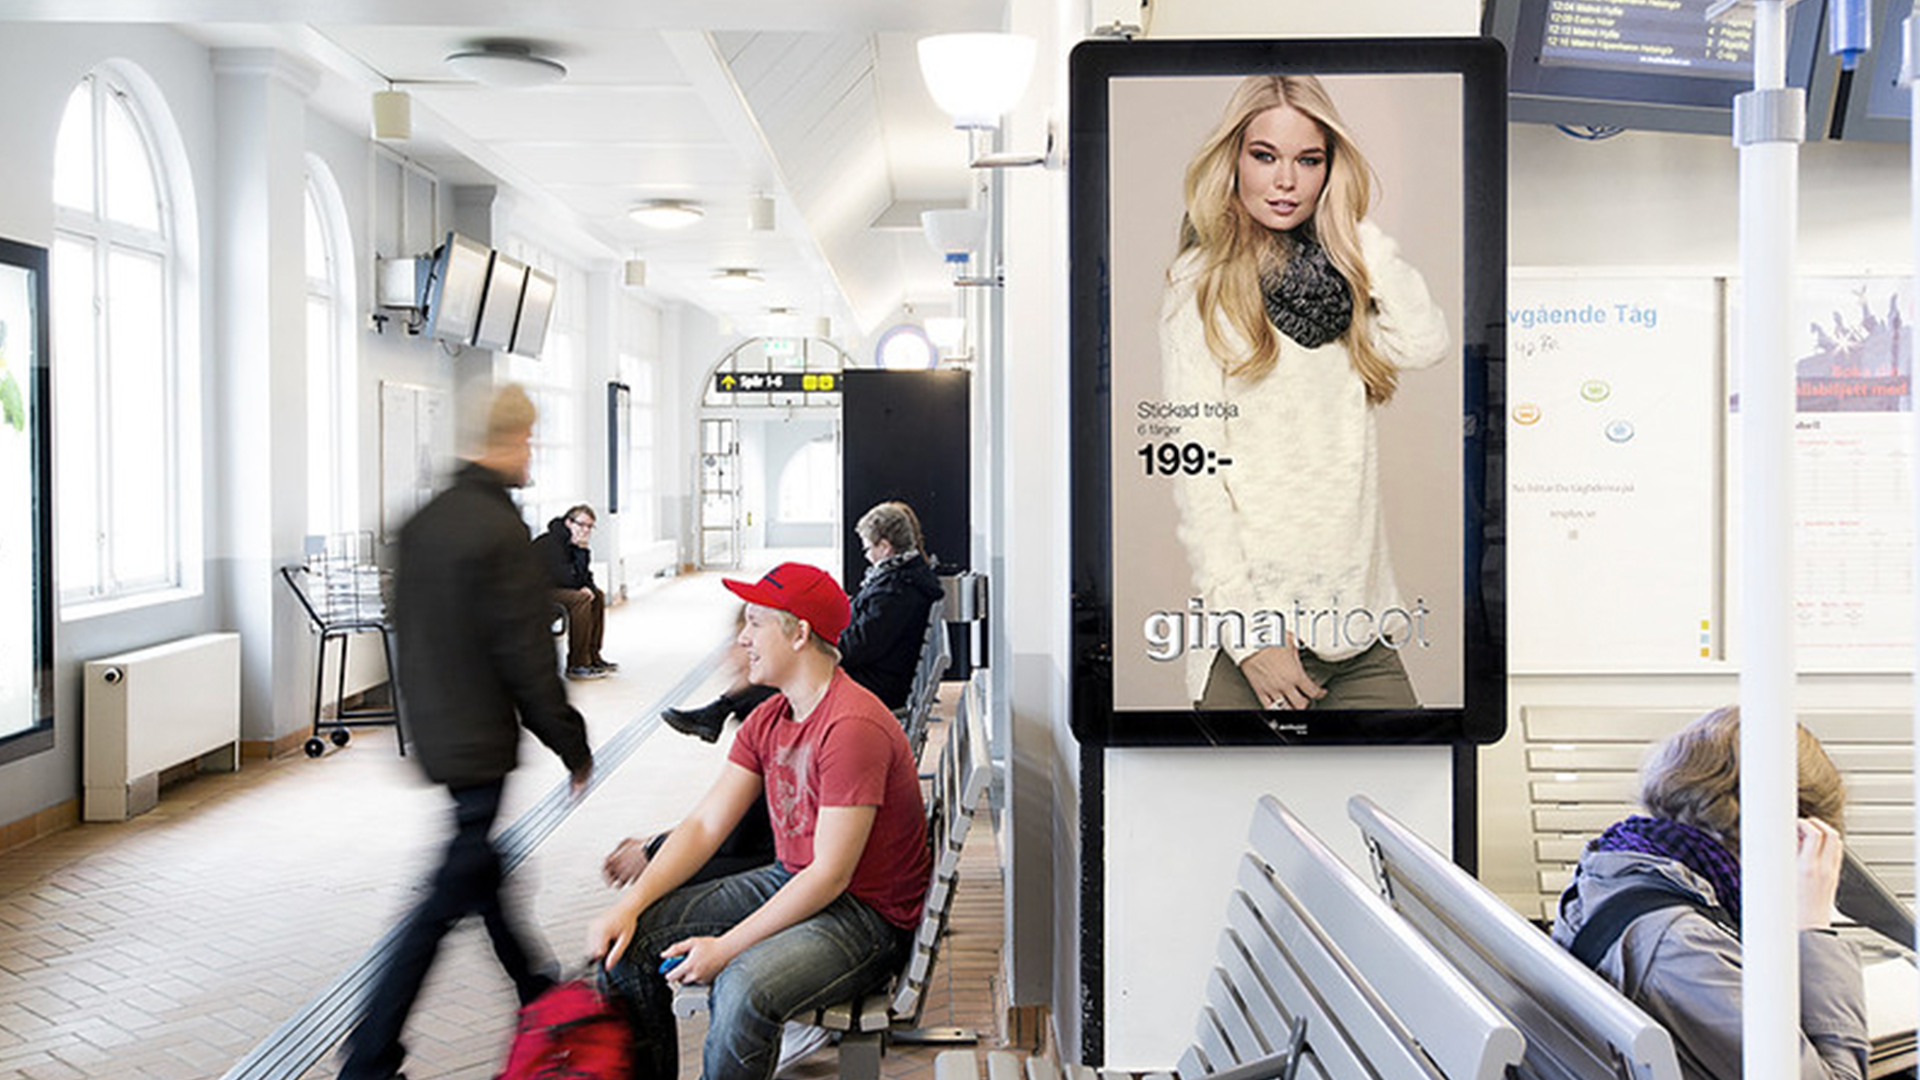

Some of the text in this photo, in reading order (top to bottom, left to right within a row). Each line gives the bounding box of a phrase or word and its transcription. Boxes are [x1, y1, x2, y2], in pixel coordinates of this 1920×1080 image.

[1614, 304, 1657, 328] Tåg
[1137, 401, 1239, 421] Stickad tröja
[1137, 425, 1147, 436] 6
[1138, 442, 1233, 476] 199:-
